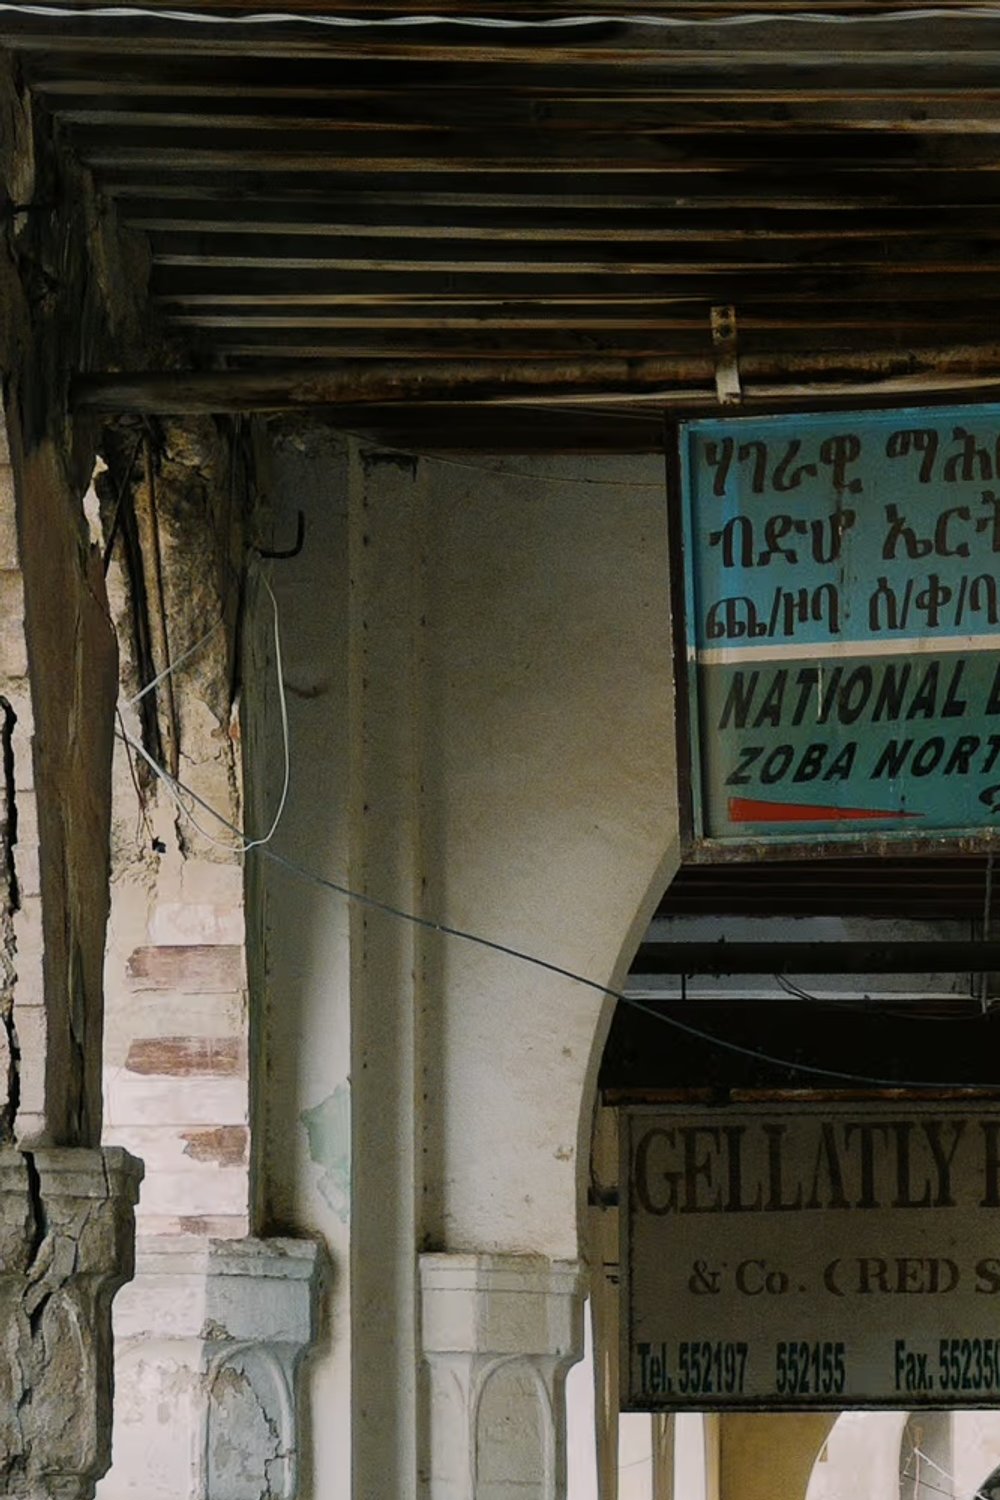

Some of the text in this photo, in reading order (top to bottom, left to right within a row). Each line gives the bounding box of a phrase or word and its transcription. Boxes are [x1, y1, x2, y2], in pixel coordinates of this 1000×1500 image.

[705, 434, 863, 496] ሃገራዊ
[709, 509, 857, 568] ብድሆ
[718, 659, 967, 730] NATIONAL
[725, 742, 858, 786] ZOBA
[634, 1119, 965, 1216] GELLATLY
[688, 1260, 721, 1295] &
[678, 1342, 748, 1393] 552197
[776, 1342, 846, 1394] 552155
